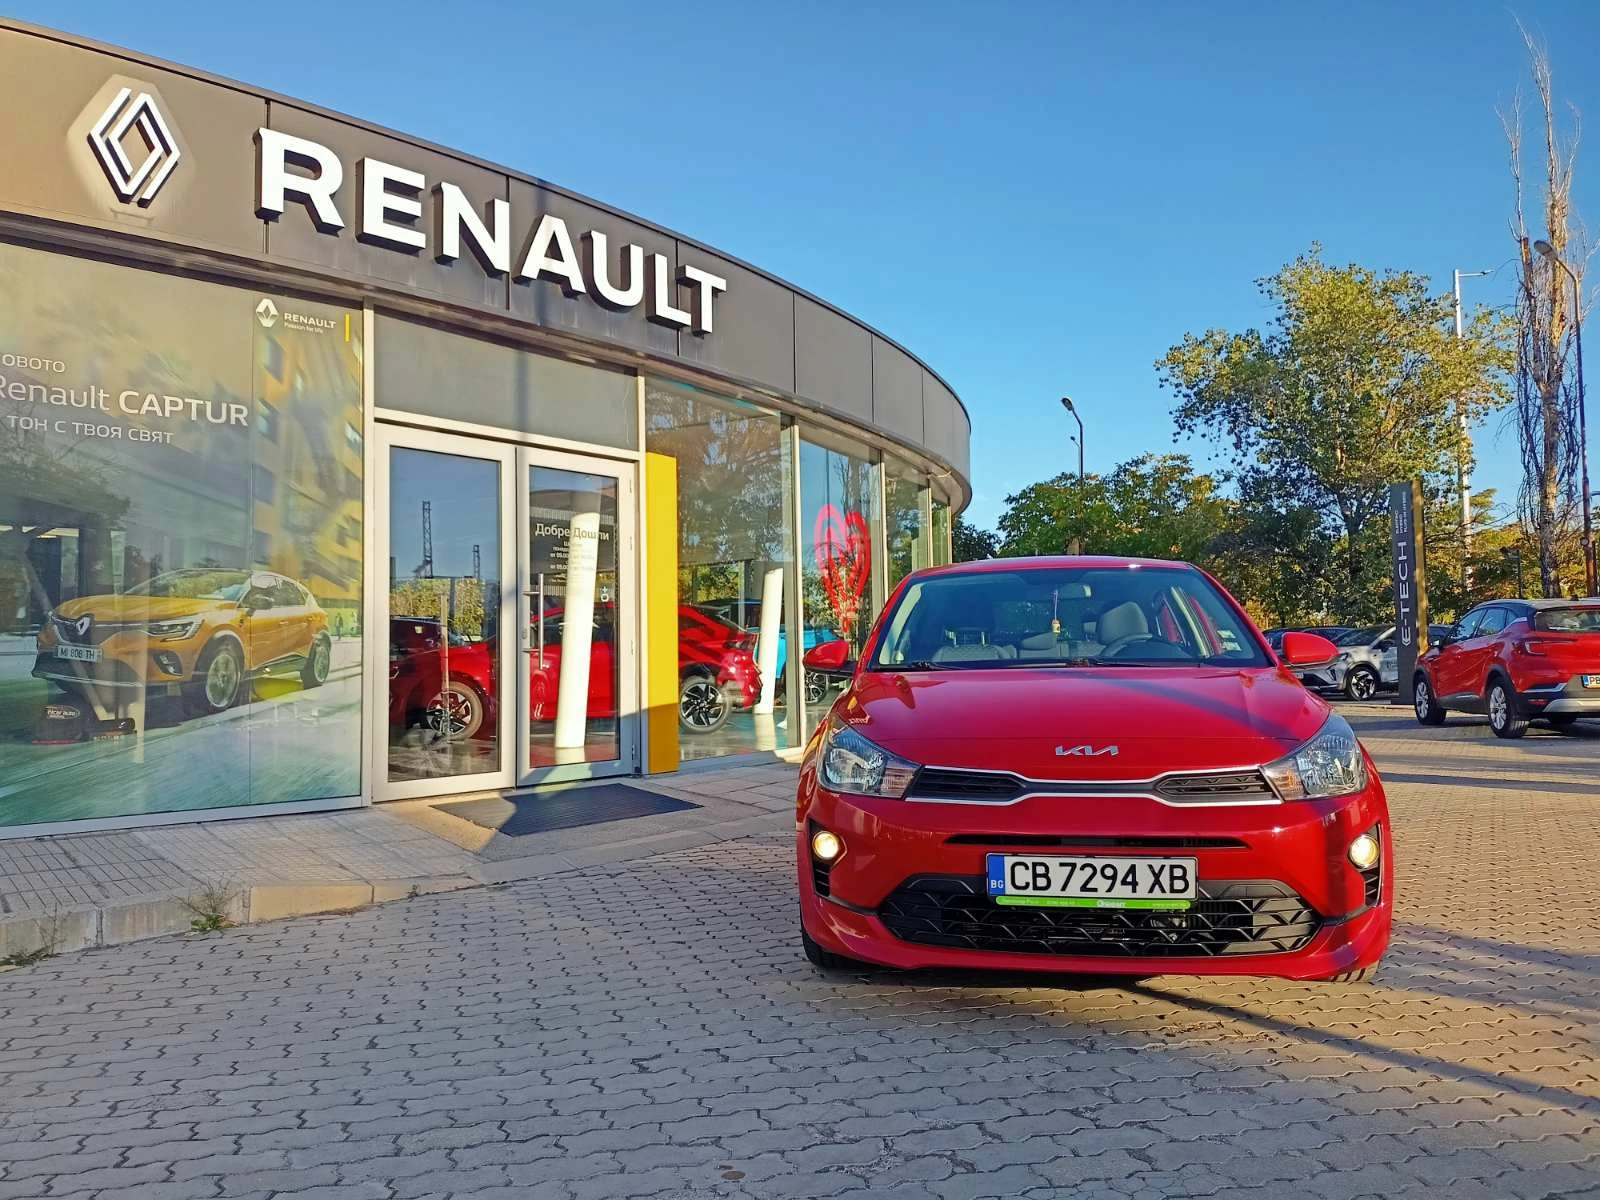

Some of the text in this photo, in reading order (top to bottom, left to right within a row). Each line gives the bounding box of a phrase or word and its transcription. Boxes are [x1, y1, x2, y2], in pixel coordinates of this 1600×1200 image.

[256, 127, 727, 336] RENAULT
[284, 312, 337, 329] RENAULT
[119, 390, 249, 427] CAPTUR
[7, 415, 48, 432] ТОН
[72, 422, 122, 439] ТВОЯ
[128, 428, 175, 444] СВЯТ
[535, 523, 571, 539] Добре
[1397, 541, 1412, 648] E-TECH
[990, 879, 1004, 889] BG
[1010, 861, 1190, 894] CB 7294 XB
